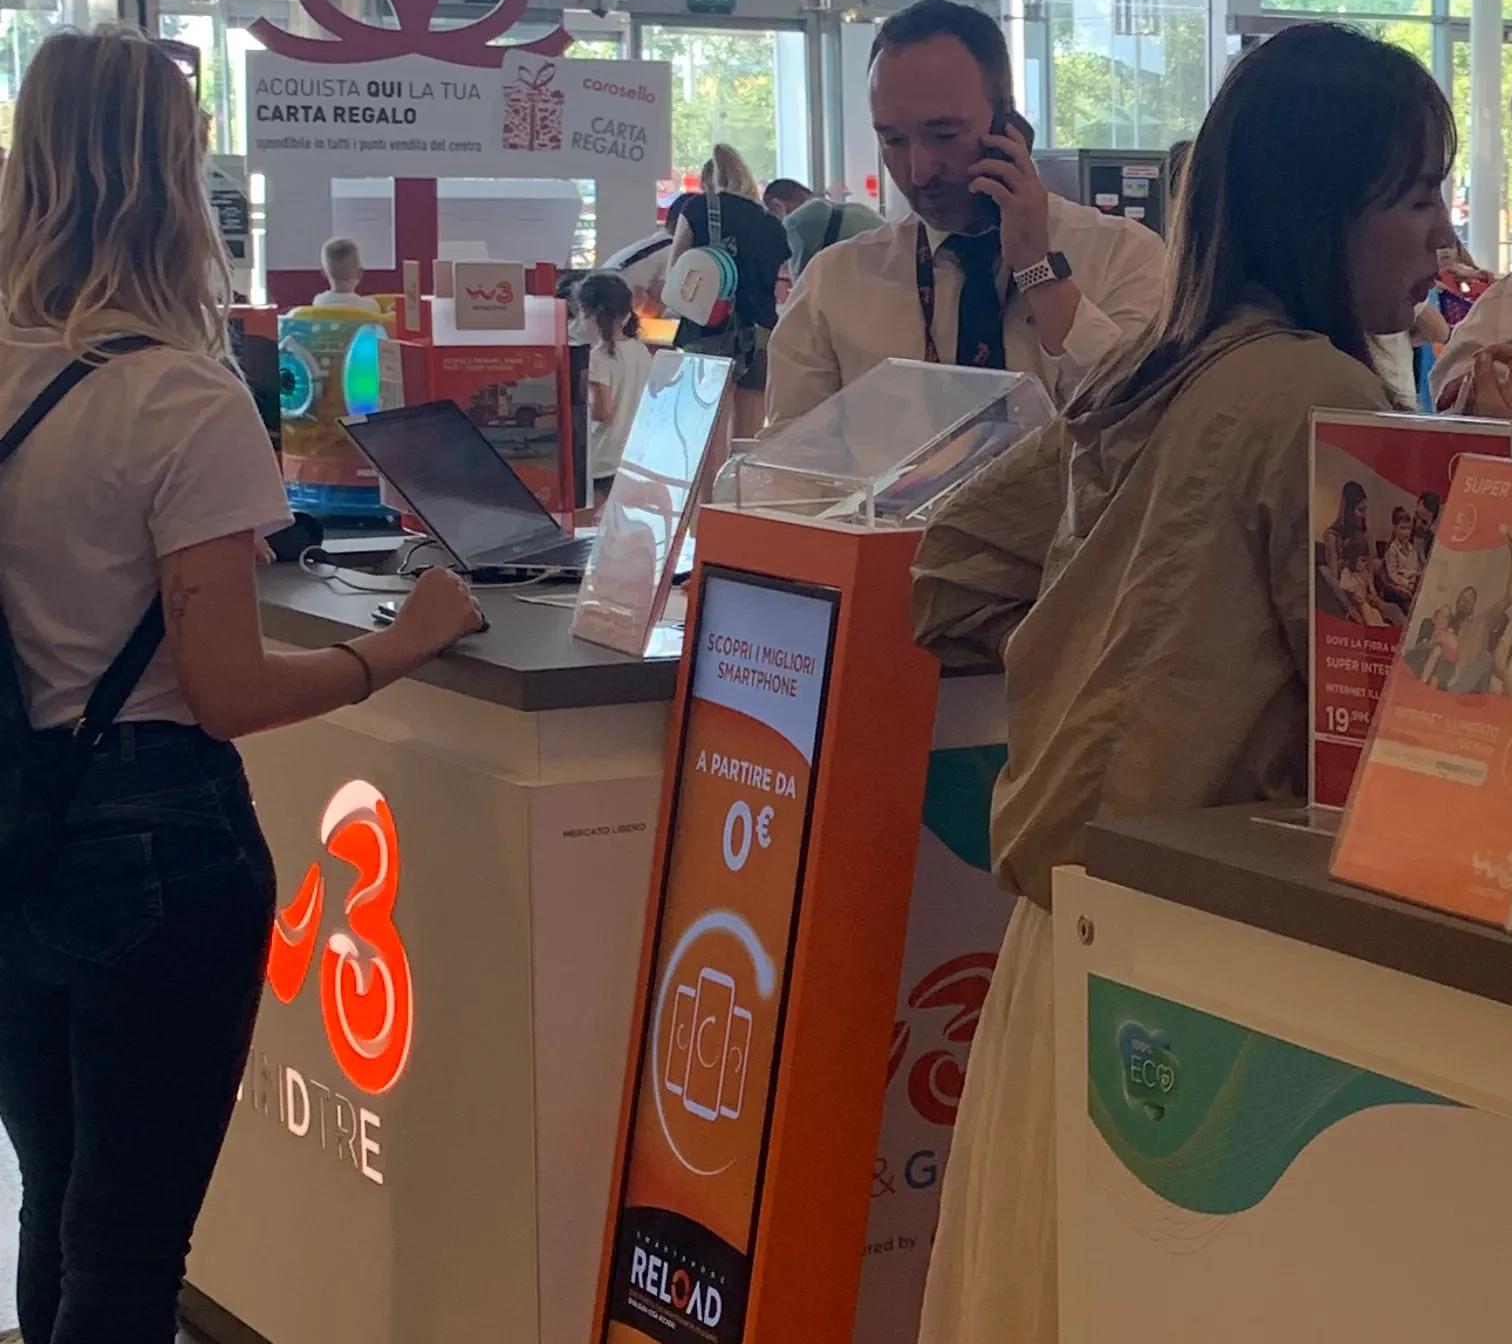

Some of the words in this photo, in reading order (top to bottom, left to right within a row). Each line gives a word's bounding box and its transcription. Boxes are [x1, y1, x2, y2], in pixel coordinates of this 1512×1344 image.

[256, 77, 361, 97] ACQUISTA
[367, 81, 402, 98] QUI
[409, 82, 434, 99] LA
[440, 82, 481, 100] TUA
[582, 77, 656, 104] carosello
[256, 105, 327, 123] CARTA
[333, 107, 417, 124] REGALO
[591, 116, 648, 145] CARTA
[571, 130, 645, 162] REGALO
[1463, 476, 1511, 498] SUPER
[707, 633, 753, 661] SCOPRI
[755, 645, 761, 662] I
[762, 645, 816, 676] MIGLIORI
[1326, 656, 1360, 672] SUPER
[718, 661, 798, 698] SMARTPHONE
[696, 749, 708, 773] A
[711, 753, 773, 792] PARTIRE
[775, 774, 797, 799] DA
[630, 1246, 722, 1328] RELOAD
